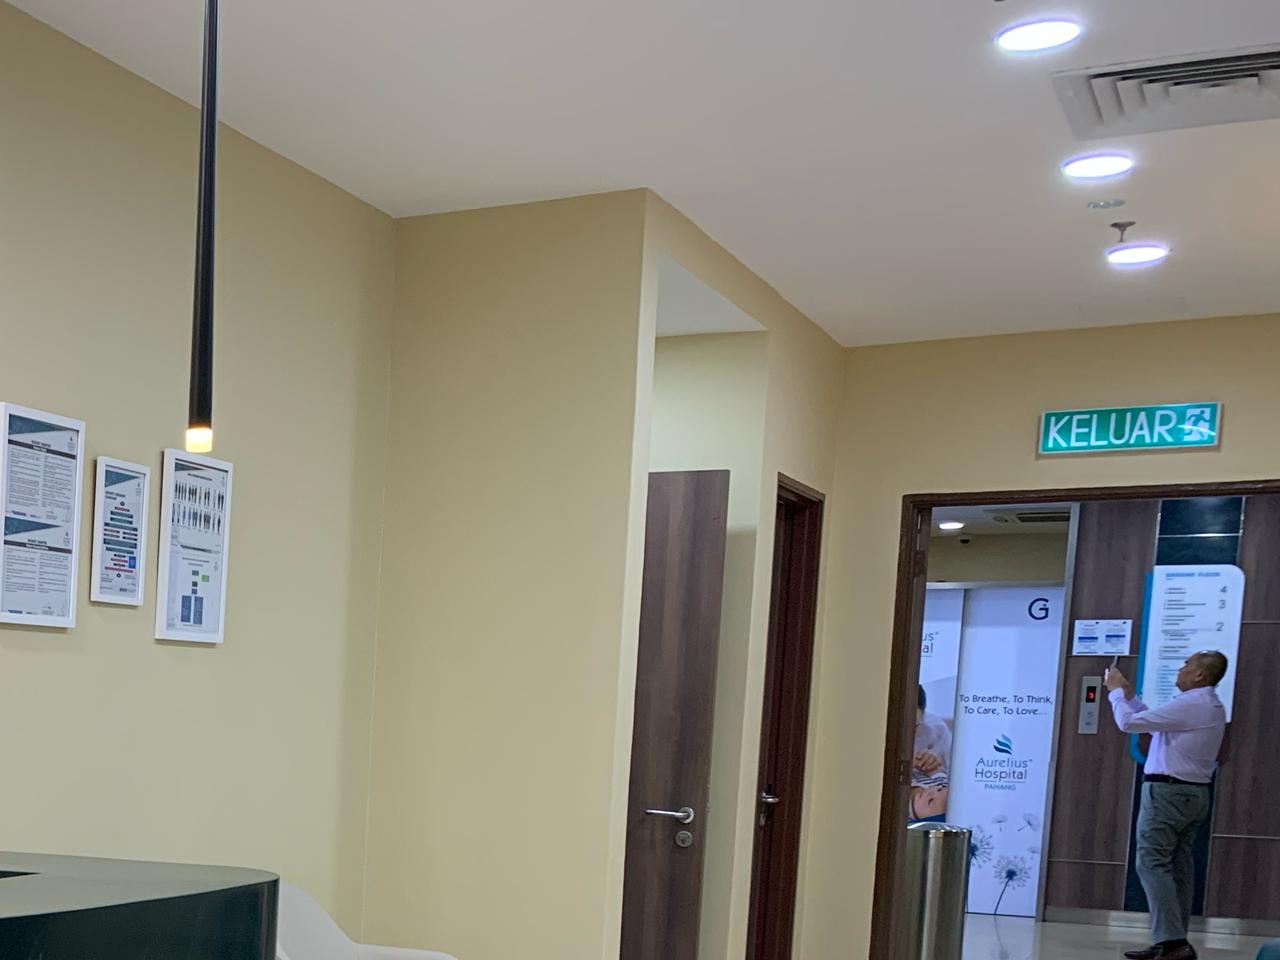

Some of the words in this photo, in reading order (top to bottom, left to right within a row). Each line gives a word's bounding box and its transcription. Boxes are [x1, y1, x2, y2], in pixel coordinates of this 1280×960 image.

[1047, 410, 1178, 449] KELUAR
[1220, 585, 1227, 593] 4
[1028, 597, 1049, 621] G
[1218, 599, 1226, 609] 3
[1216, 622, 1224, 632] 2
[959, 694, 970, 703] To
[972, 694, 1010, 704] Breathe,
[1013, 695, 1024, 704] To
[1026, 695, 1053, 704] Think,
[964, 706, 974, 715] To
[976, 706, 1000, 716] Care,
[1003, 706, 1014, 715] To
[974, 768, 1028, 781] Hospital
